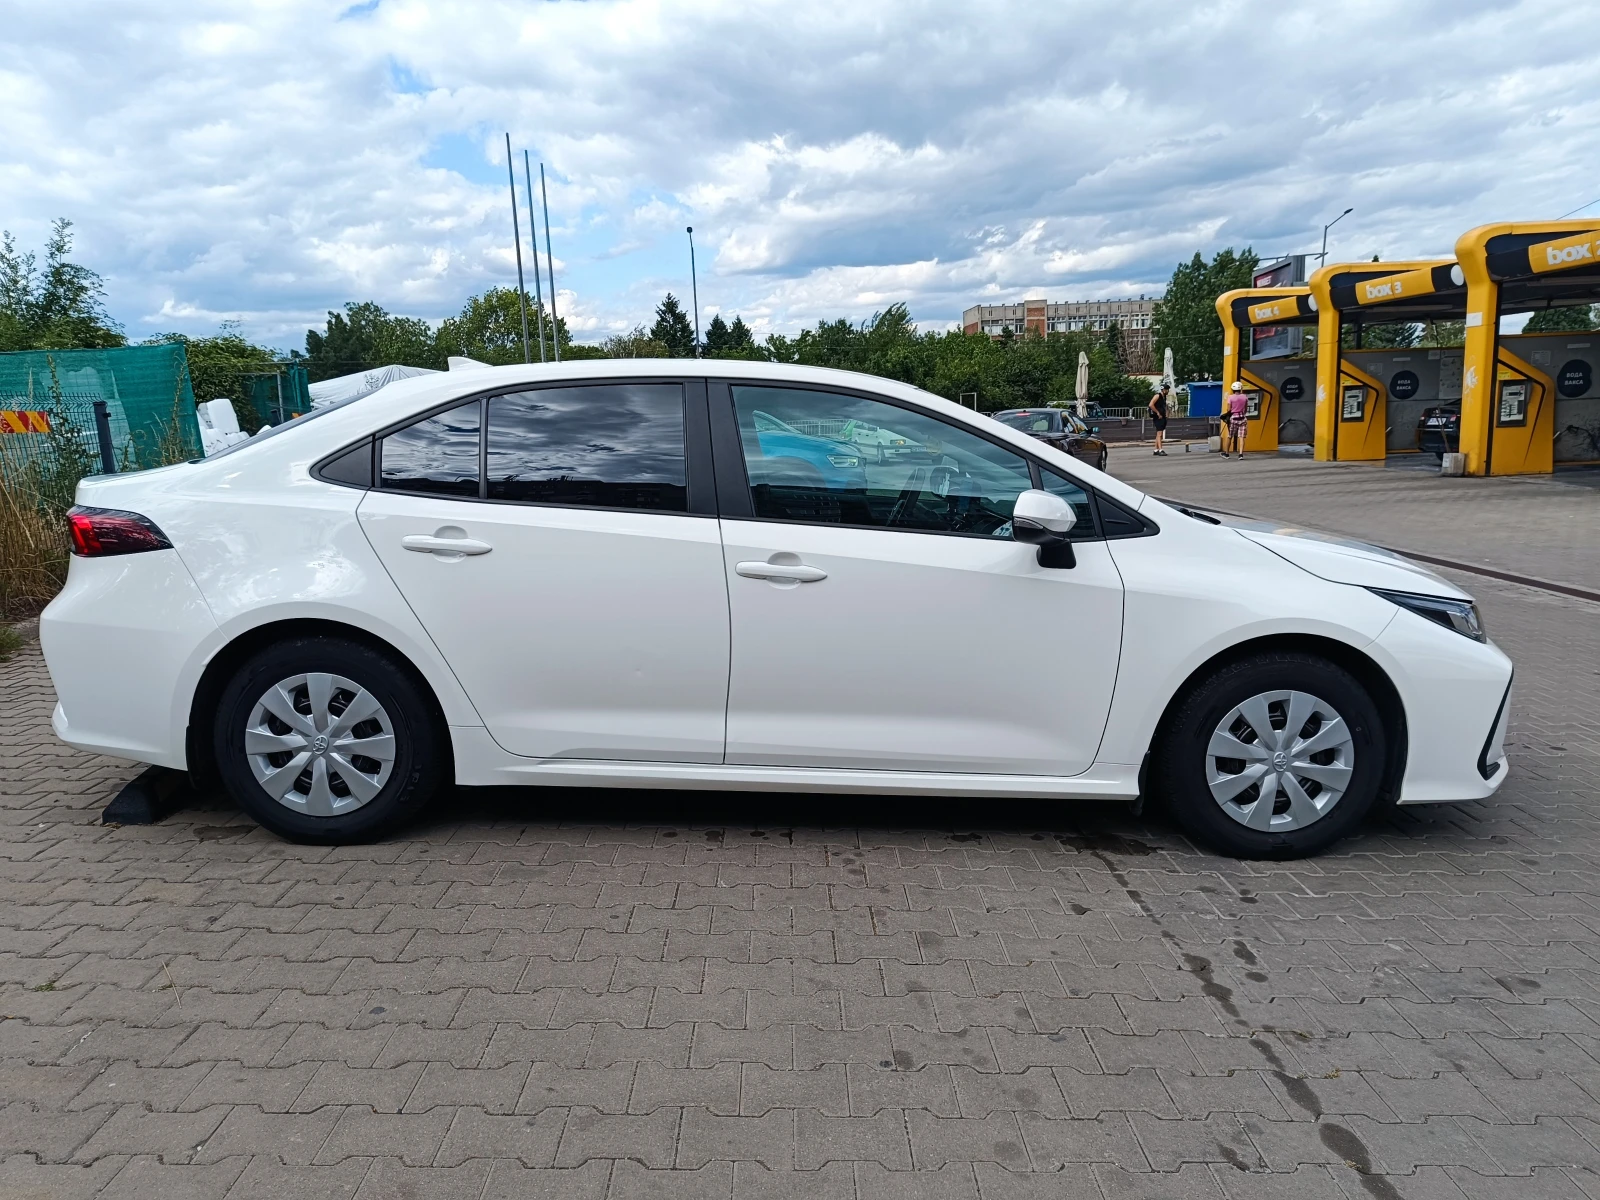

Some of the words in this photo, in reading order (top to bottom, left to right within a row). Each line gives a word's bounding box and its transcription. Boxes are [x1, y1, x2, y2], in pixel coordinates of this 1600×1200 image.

[1546, 243, 1592, 265] box
[1366, 283, 1393, 299] box
[1394, 281, 1402, 294] 3
[1255, 307, 1273, 320] box
[1273, 306, 1279, 315] 4
